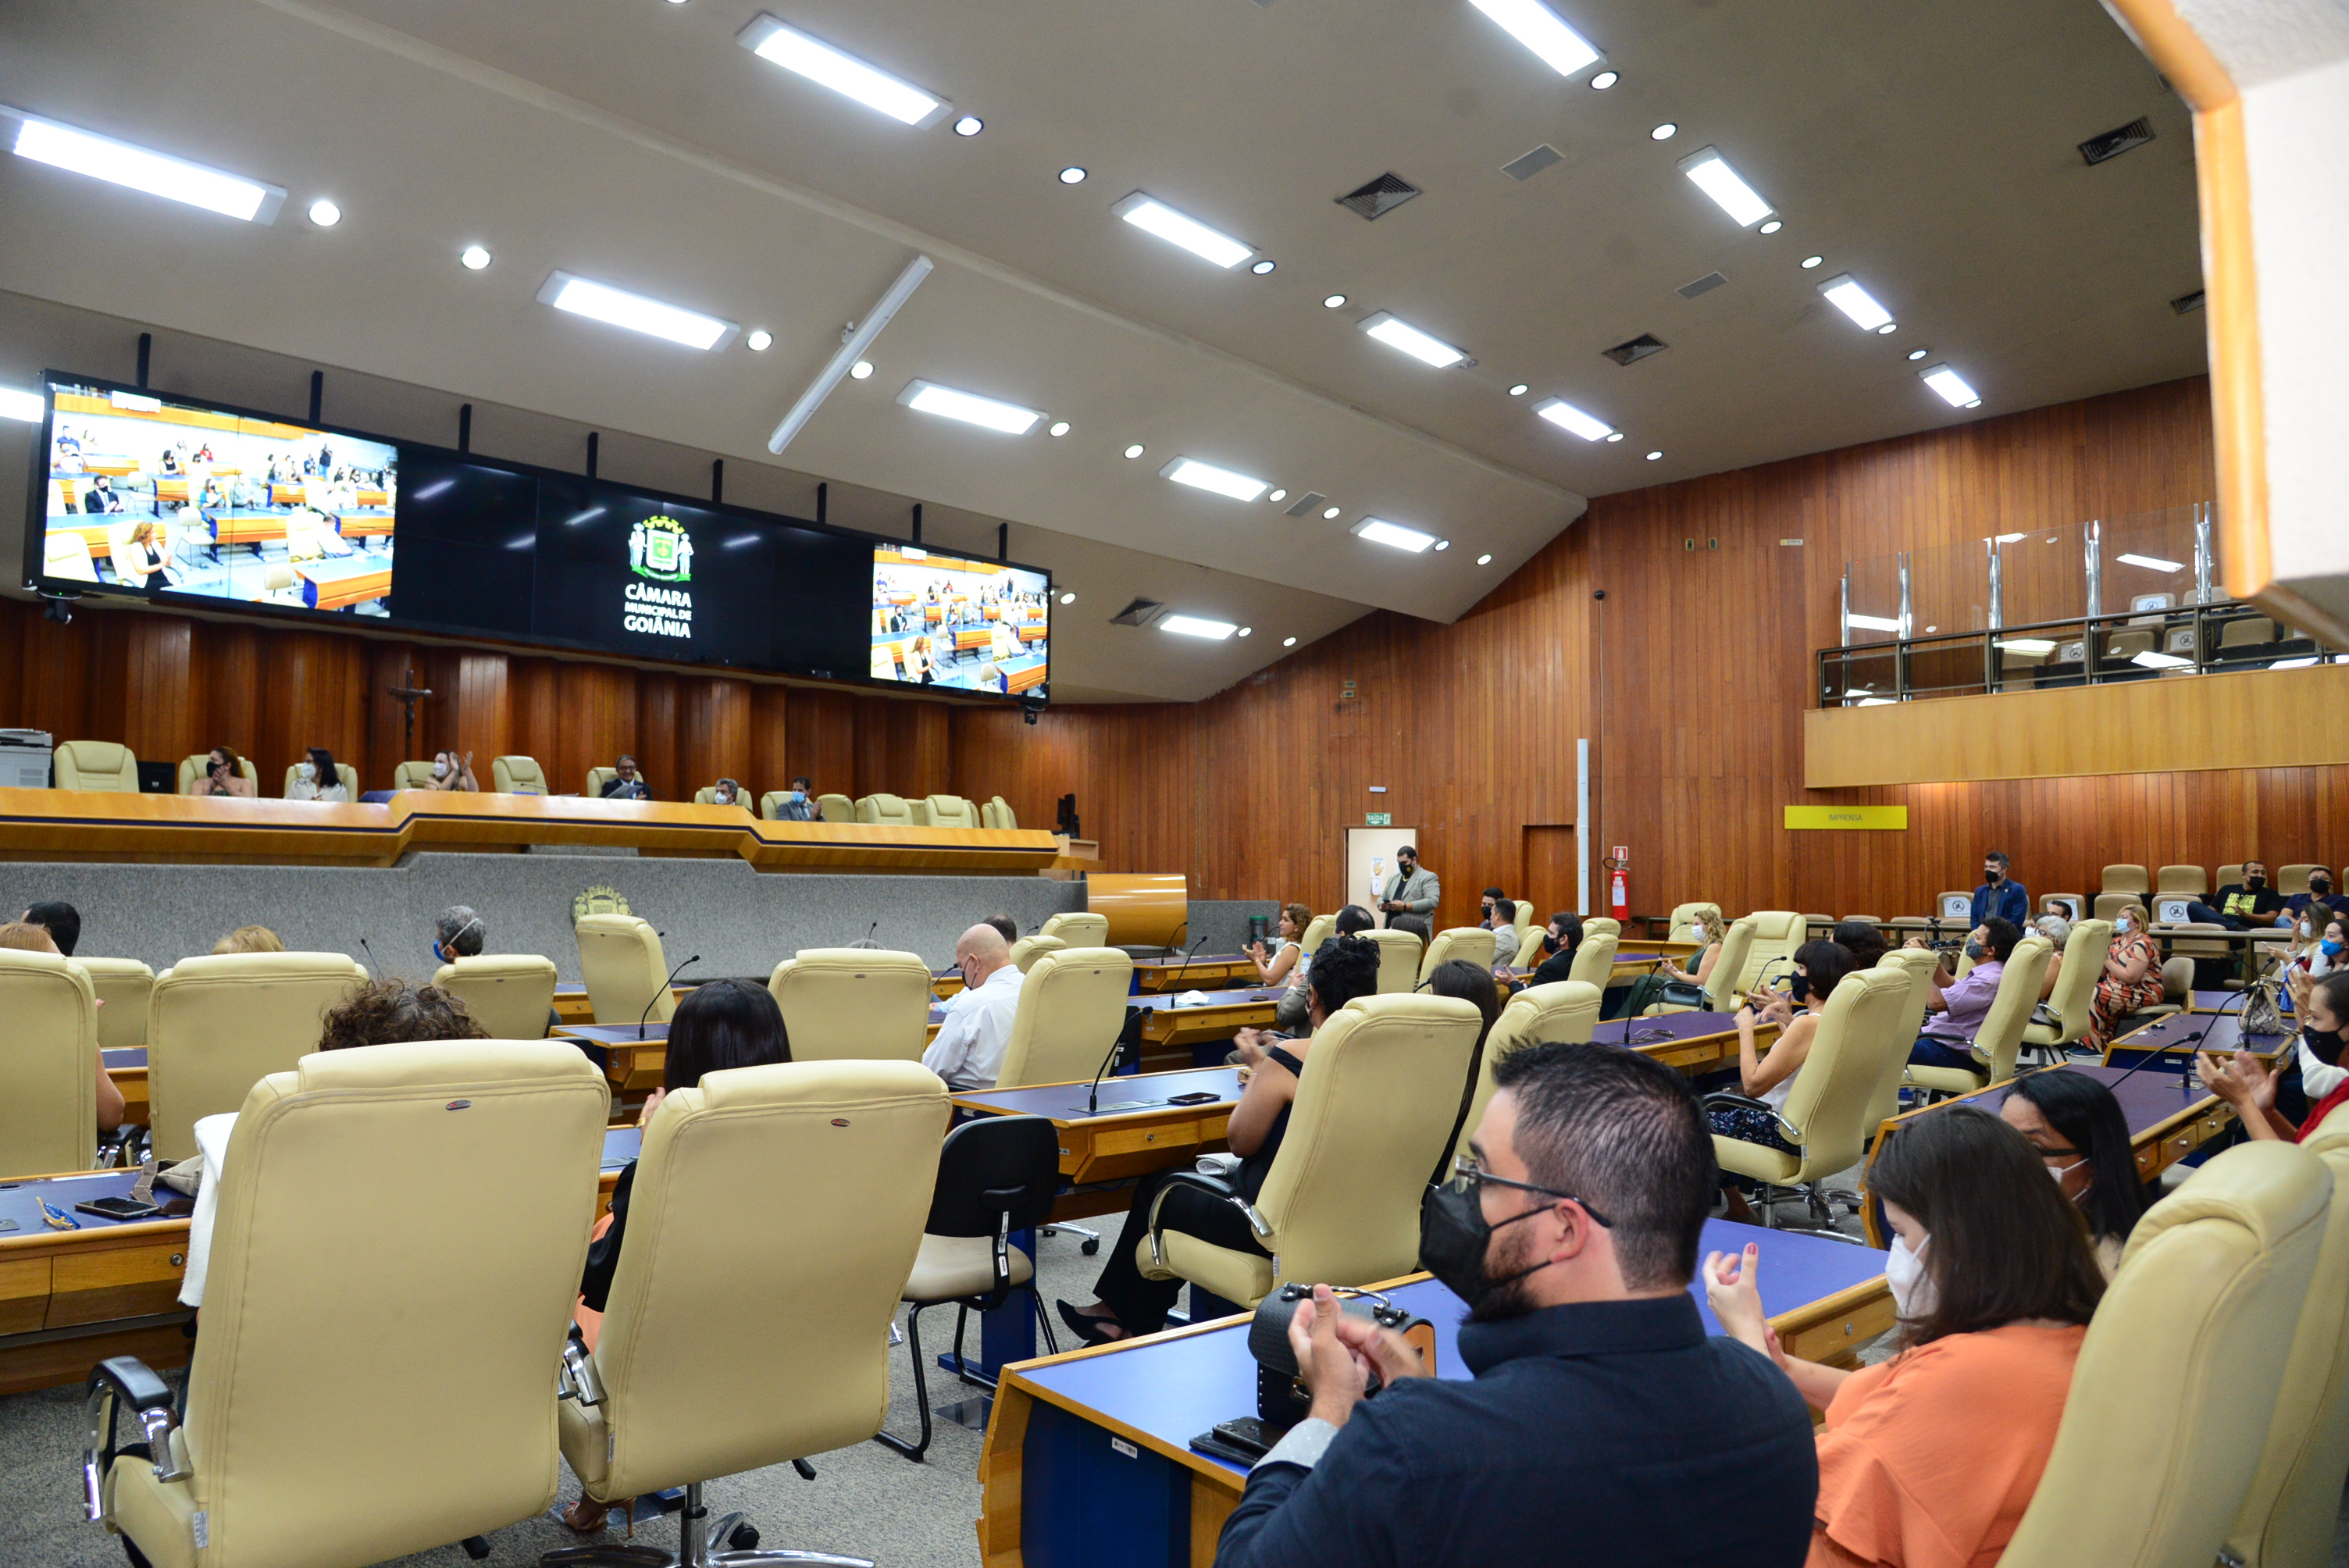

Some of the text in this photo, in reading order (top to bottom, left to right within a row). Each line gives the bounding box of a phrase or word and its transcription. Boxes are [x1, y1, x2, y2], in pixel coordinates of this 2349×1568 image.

[626, 583, 692, 608] CÂMARA
[625, 601, 692, 621] MUNICIPAL DE
[624, 615, 691, 638] GOIÂNIA
